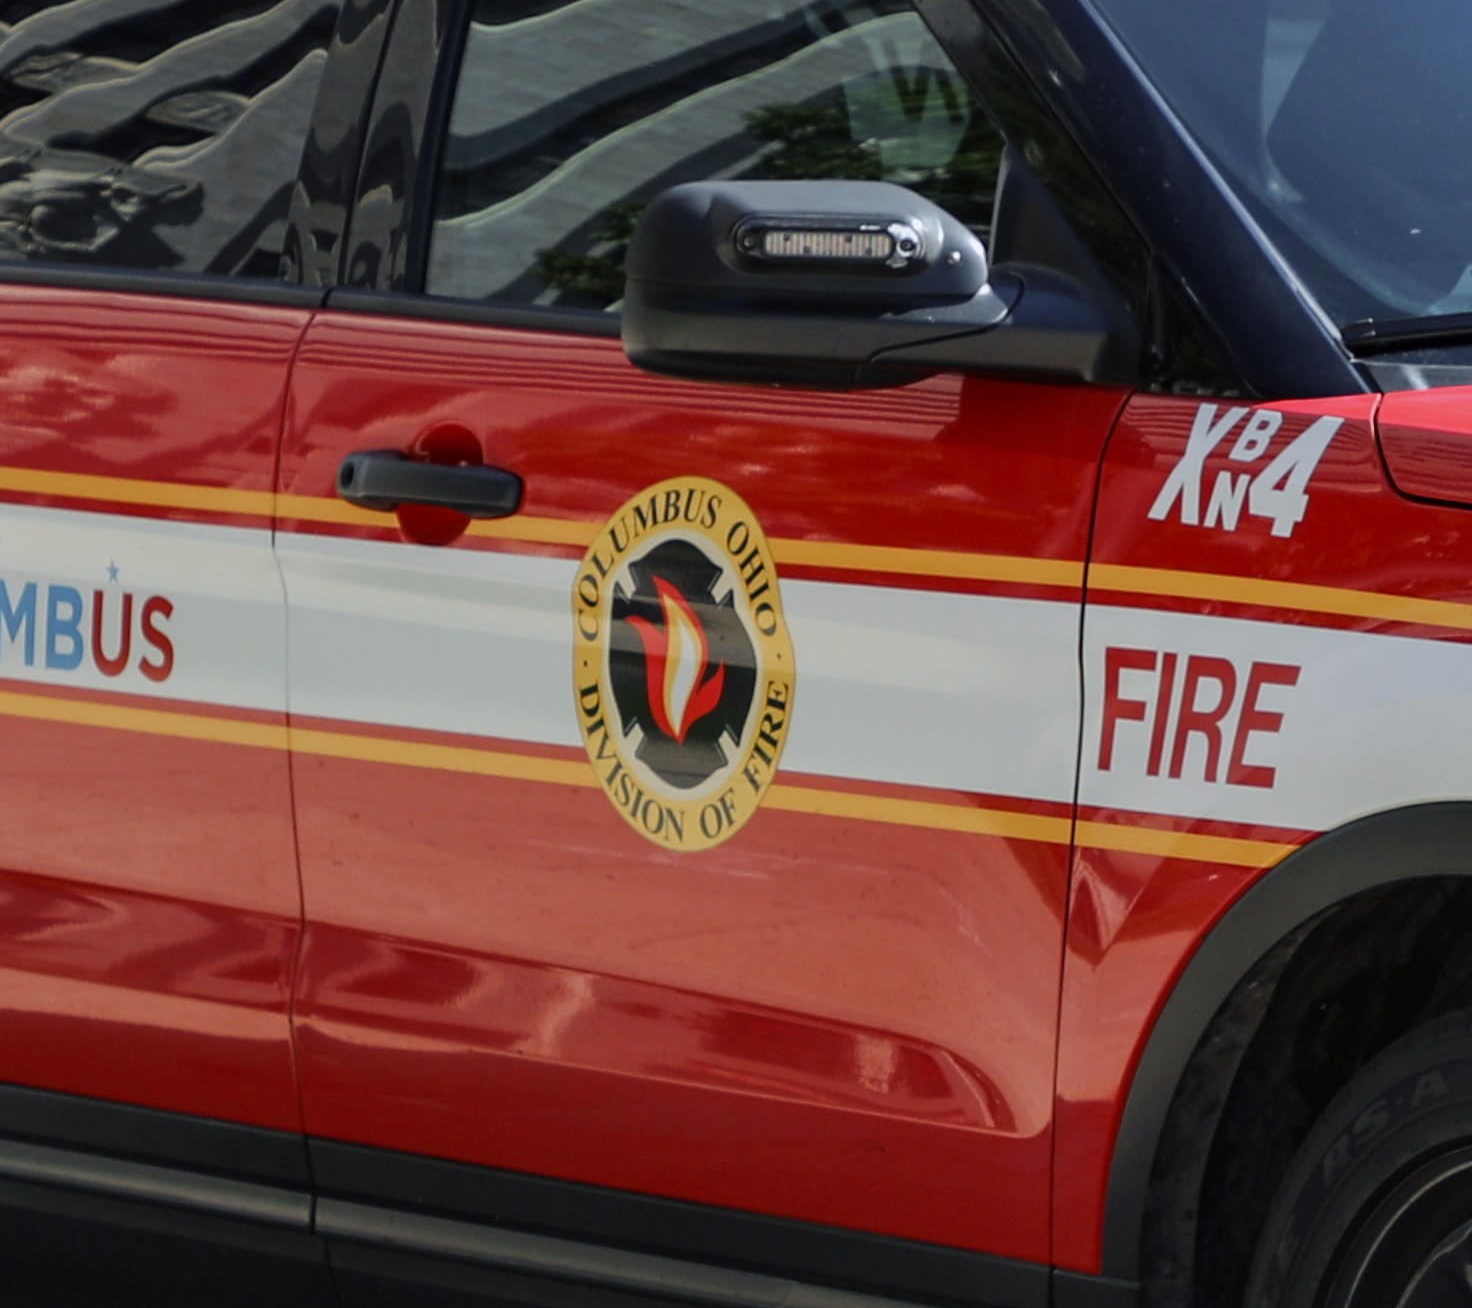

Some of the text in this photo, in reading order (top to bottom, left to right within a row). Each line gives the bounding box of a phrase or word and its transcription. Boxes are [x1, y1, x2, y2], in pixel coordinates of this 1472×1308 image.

[575, 487, 779, 642] COLUMBUS OHIO
[579, 679, 790, 844] DIVISION OF FIRE
[1097, 645, 1303, 790] FIRE
